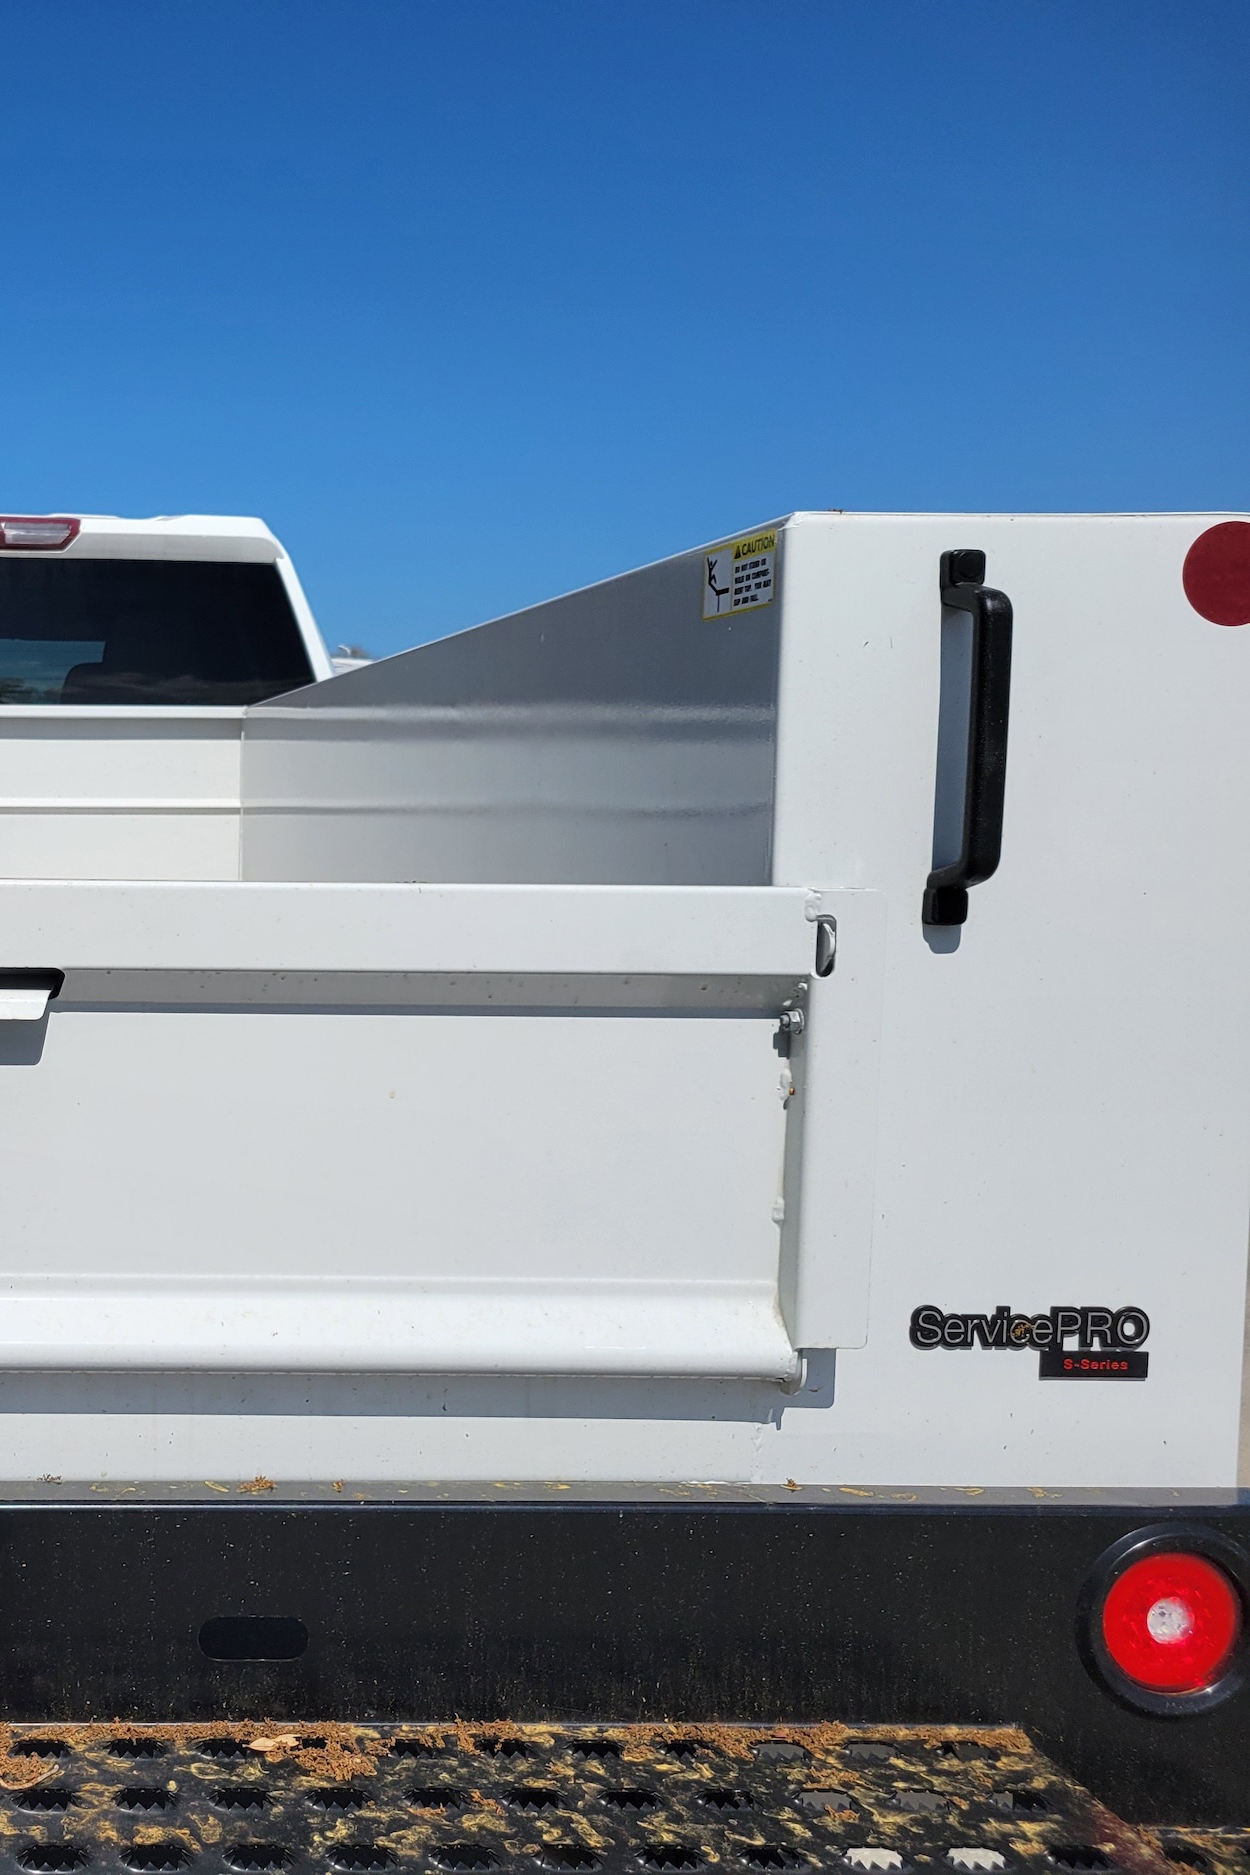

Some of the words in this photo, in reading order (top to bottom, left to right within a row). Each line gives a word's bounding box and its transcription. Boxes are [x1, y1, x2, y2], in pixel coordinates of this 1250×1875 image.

[741, 534, 775, 555] CAUTION
[913, 1307, 1149, 1348] ServicePRO
[1063, 1358, 1129, 1371] S-Series
